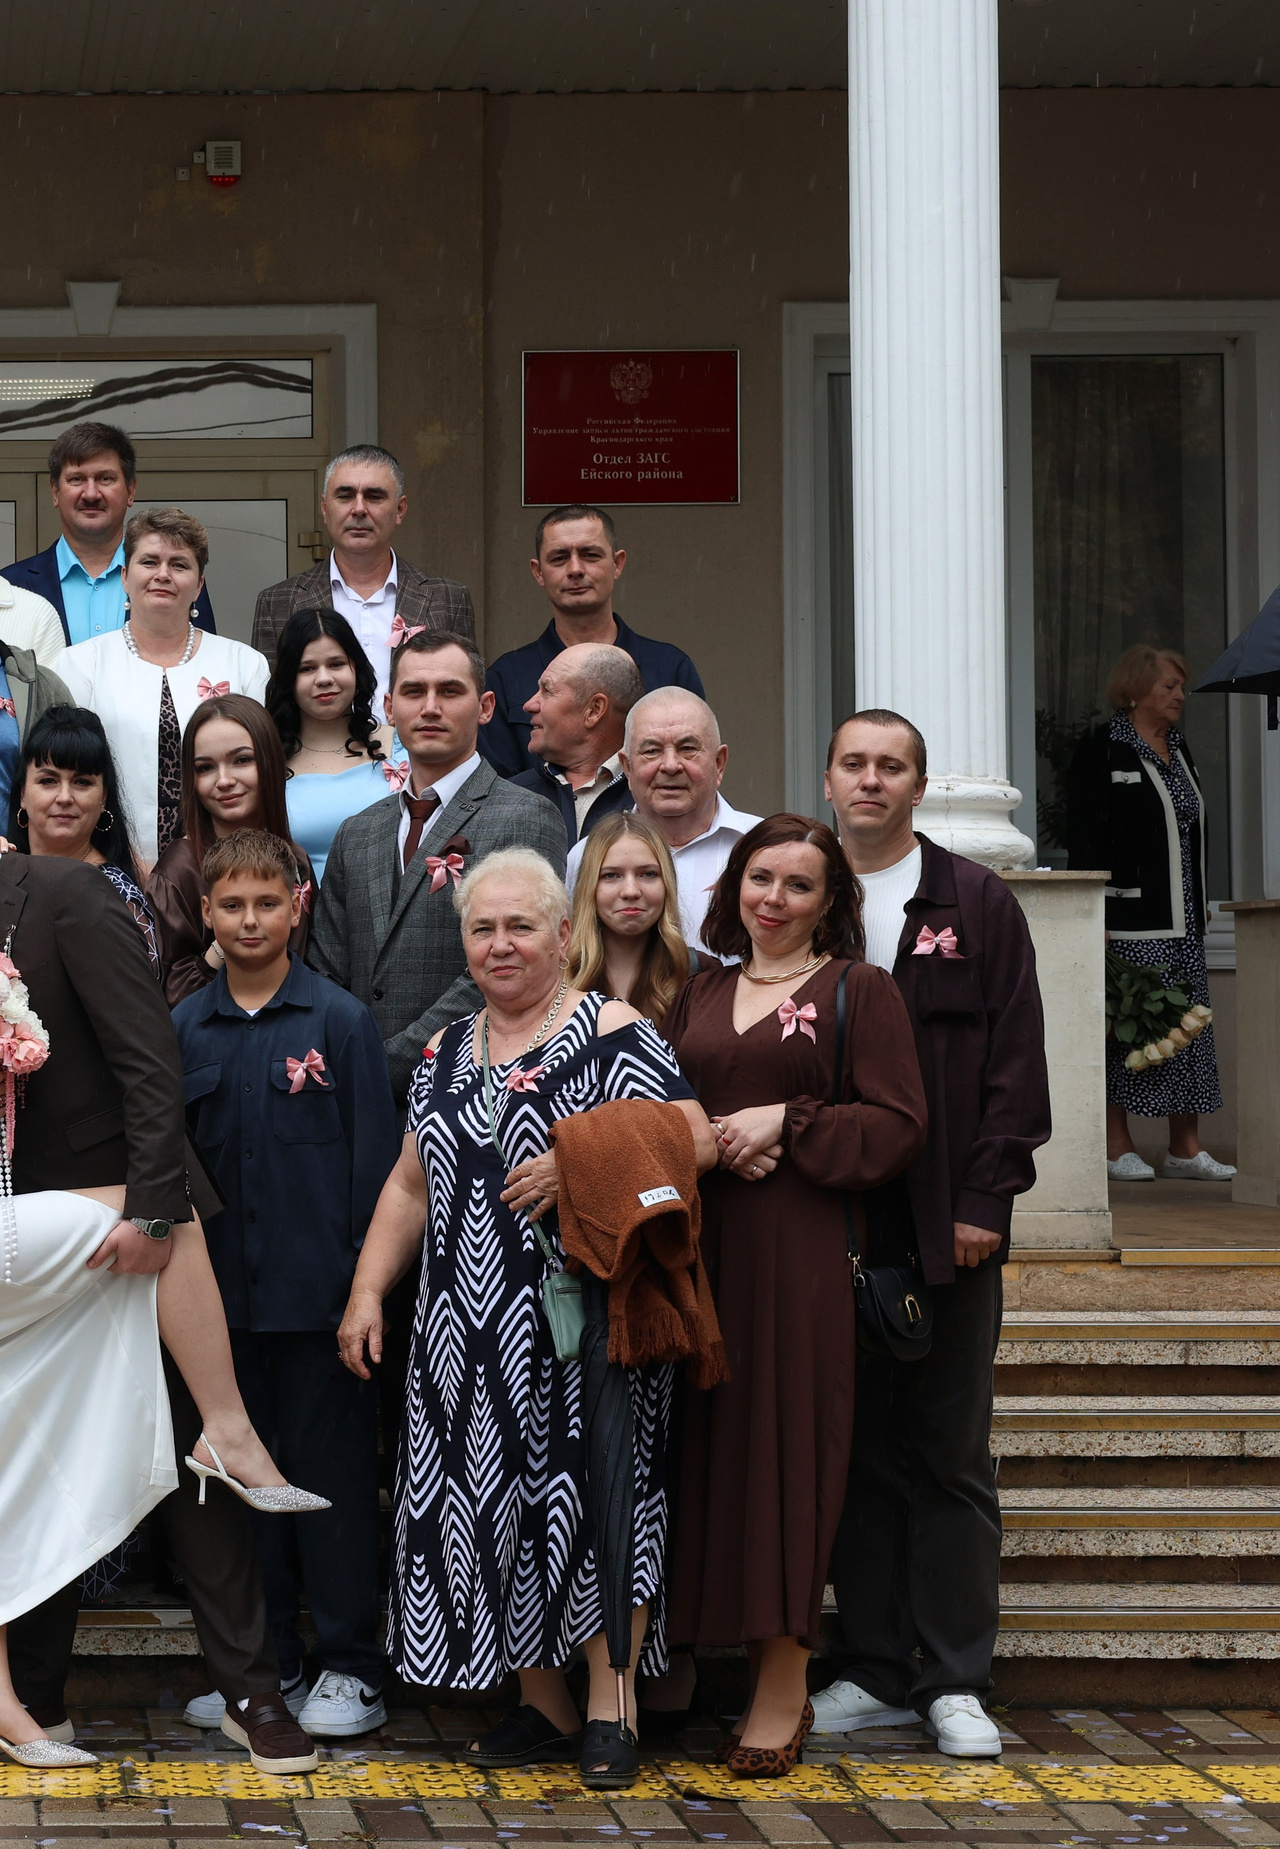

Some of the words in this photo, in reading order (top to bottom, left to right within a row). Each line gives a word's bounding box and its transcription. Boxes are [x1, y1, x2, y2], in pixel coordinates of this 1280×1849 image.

[586, 417, 631, 425] Российская
[633, 417, 677, 426] Федерация
[532, 427, 579, 436] Управление
[590, 436, 653, 444] Краснодарского
[593, 452, 631, 464] Отдел
[636, 452, 671, 464] ЗАГС
[580, 467, 632, 480] Ейского
[637, 467, 683, 482] района
